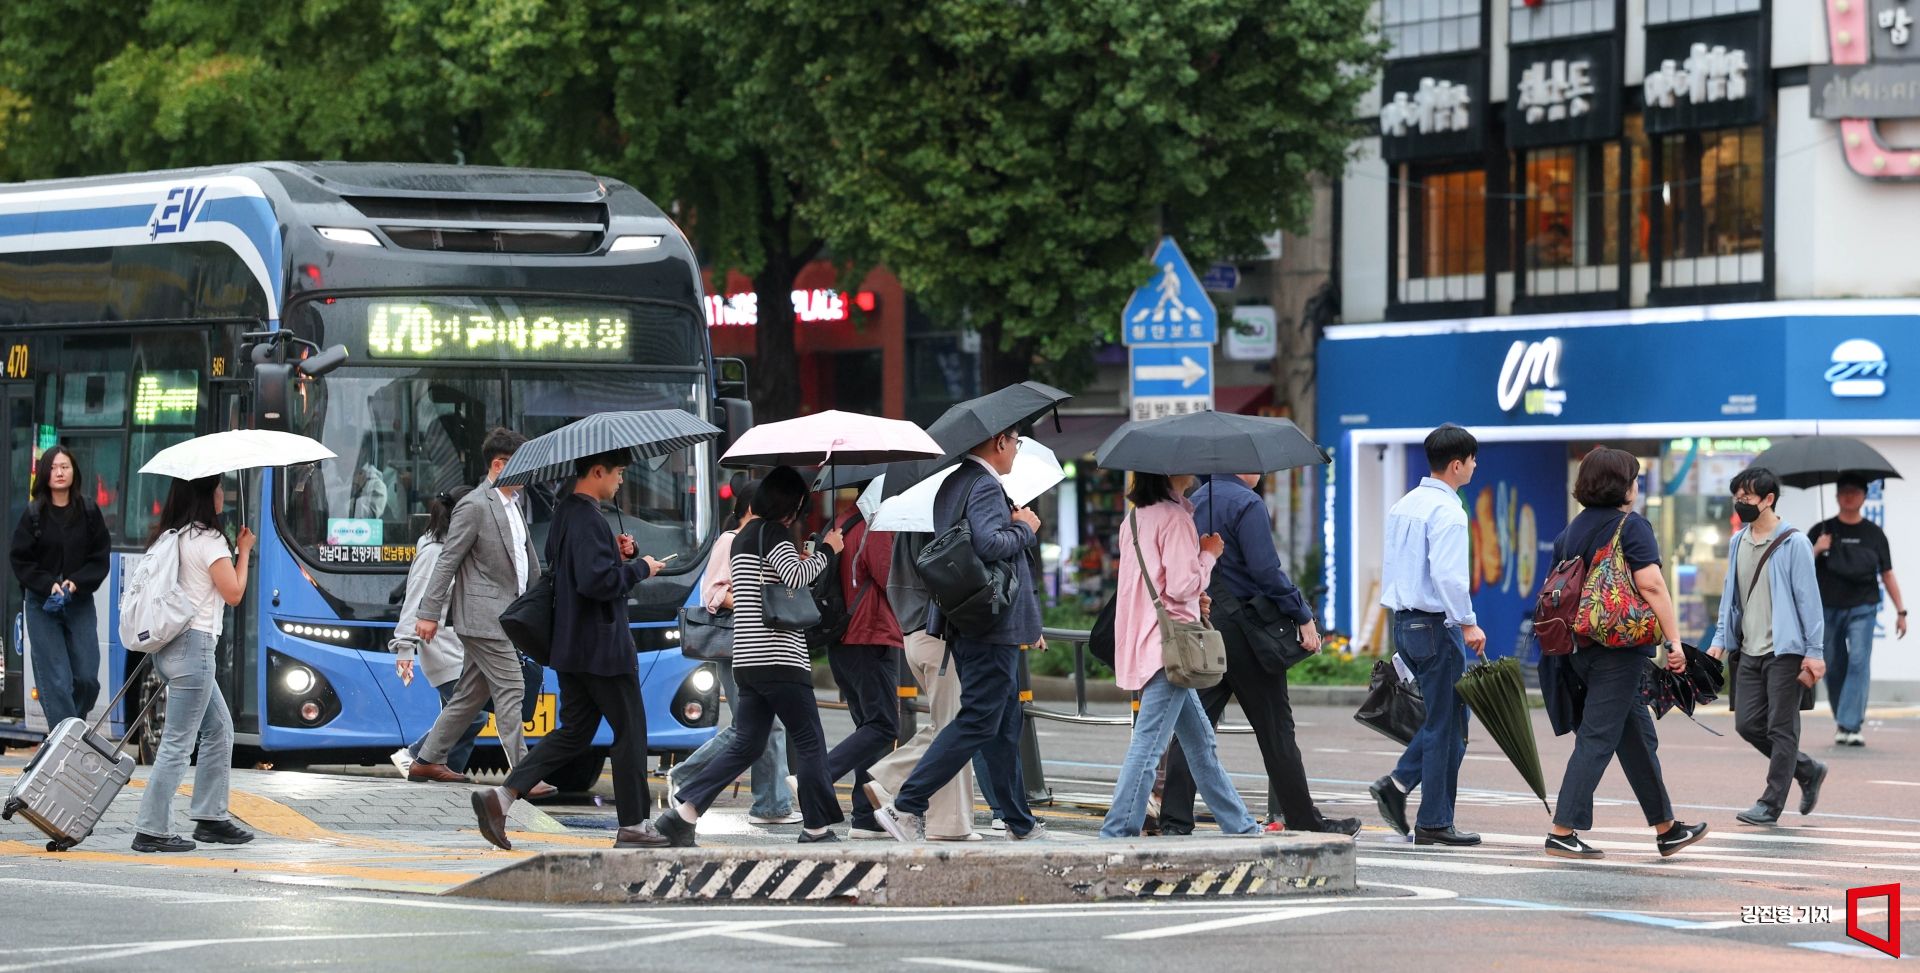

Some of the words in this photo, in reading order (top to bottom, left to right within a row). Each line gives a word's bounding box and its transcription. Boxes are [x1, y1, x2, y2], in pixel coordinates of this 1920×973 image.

[151, 185, 207, 239] EV
[369, 306, 432, 352] 470
[7, 344, 28, 378] 470
[320, 545, 349, 562] 한남대교
